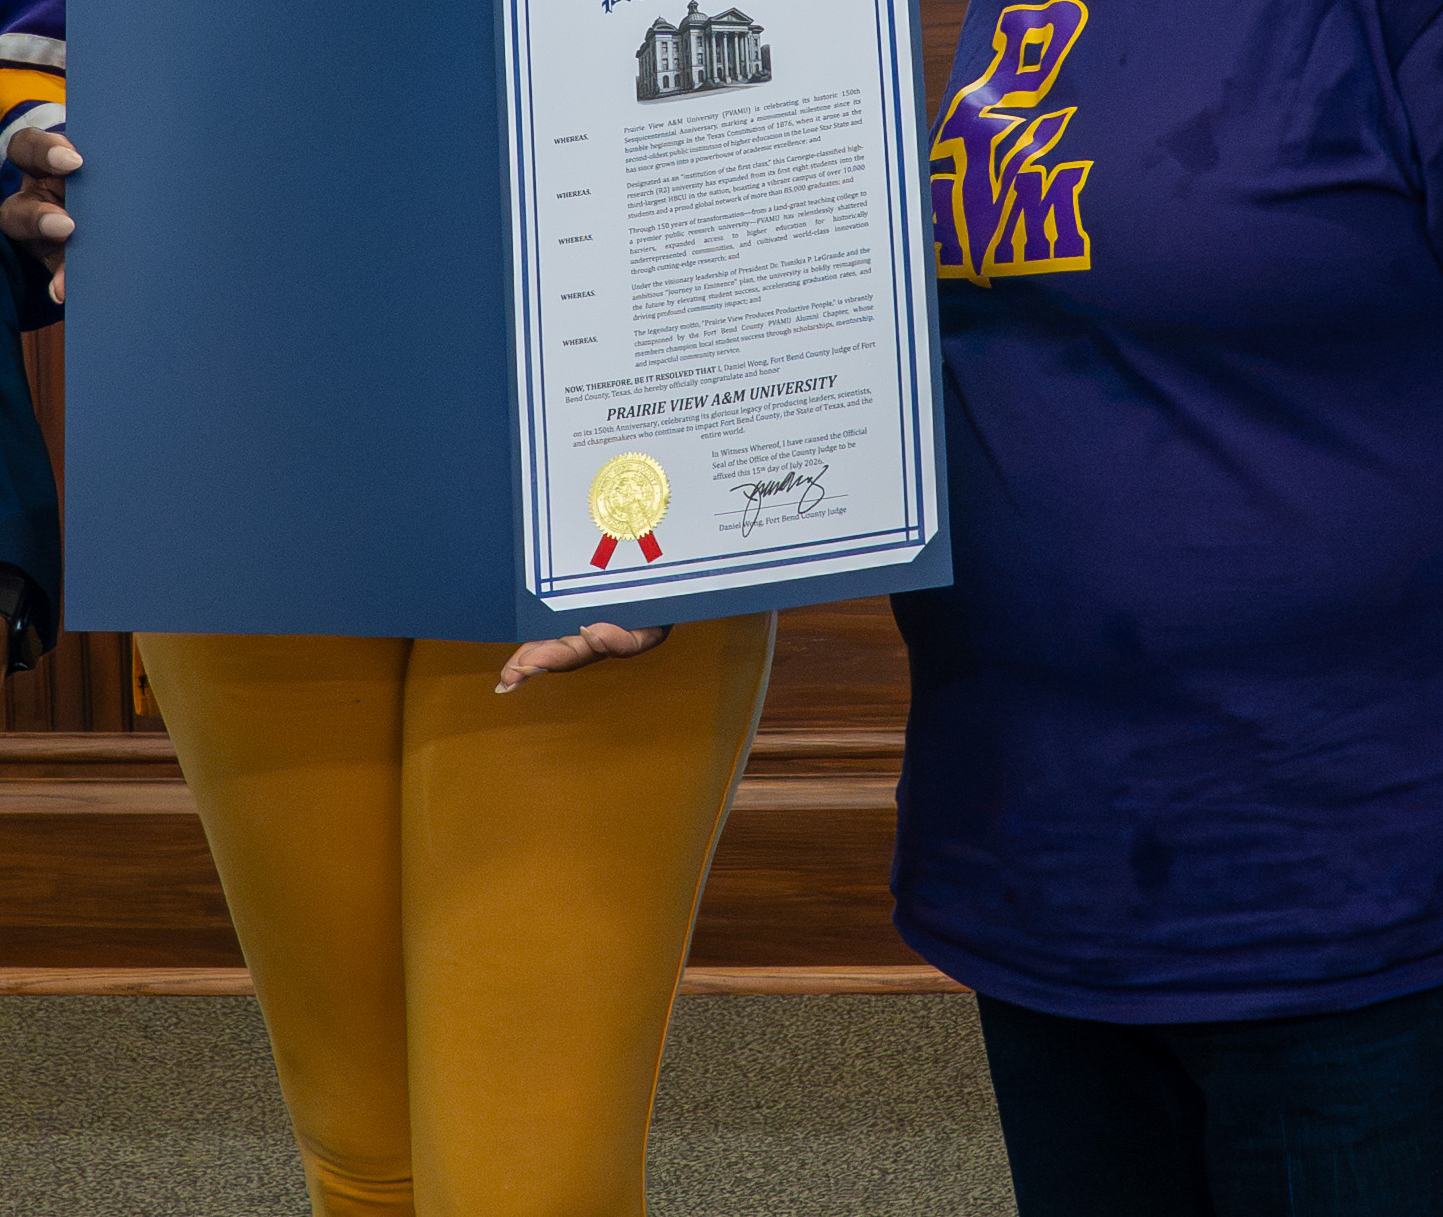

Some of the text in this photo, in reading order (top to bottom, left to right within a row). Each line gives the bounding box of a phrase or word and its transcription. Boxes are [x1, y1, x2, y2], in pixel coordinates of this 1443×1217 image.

[607, 375, 837, 421] PRAIRIE VIEW A&M UNIVERSITY
